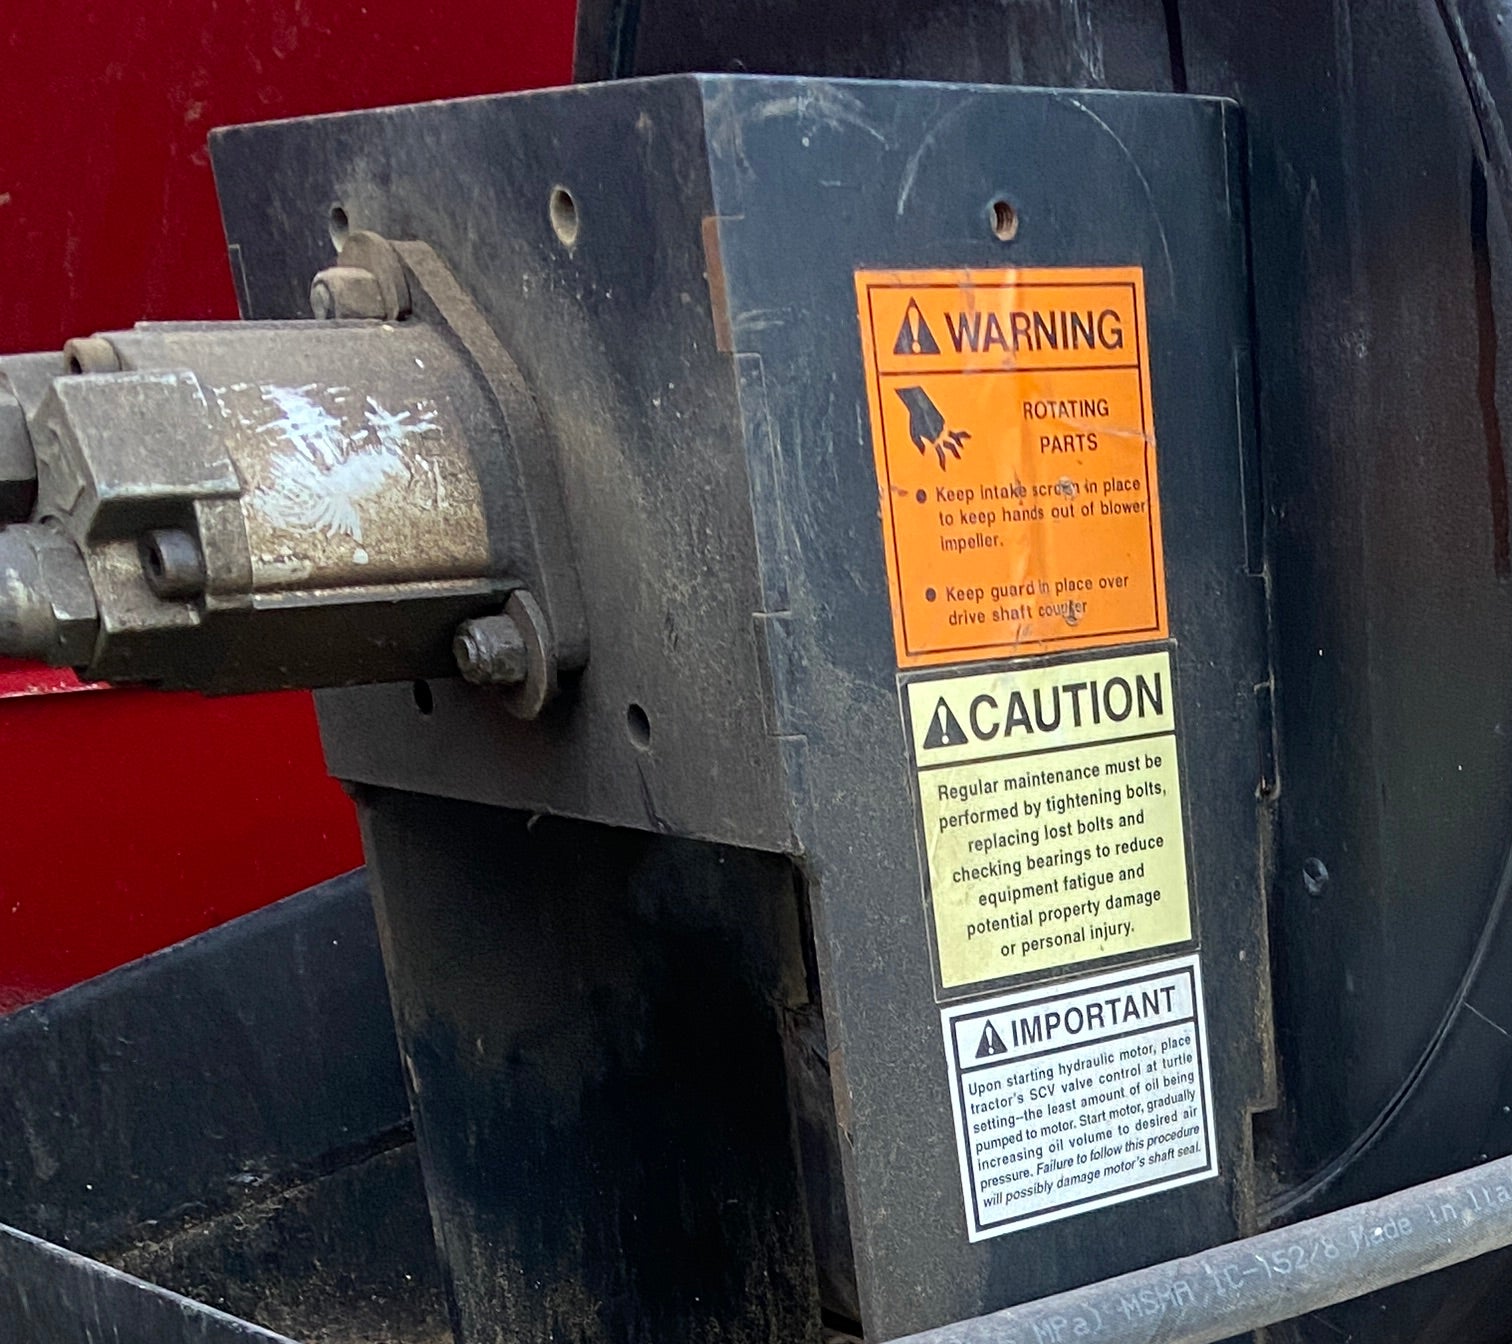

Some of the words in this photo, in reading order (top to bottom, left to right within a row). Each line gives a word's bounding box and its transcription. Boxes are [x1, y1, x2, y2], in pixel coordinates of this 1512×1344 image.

[944, 309, 1123, 353] WARNING
[1023, 399, 1109, 420] ROTATING
[1040, 433, 1098, 453] PARTS
[936, 486, 974, 507] Keep
[980, 482, 1027, 500] intake
[1032, 482, 1080, 496] scren
[1084, 478, 1098, 494] in
[1103, 477, 1140, 496] place
[939, 510, 953, 526] to
[960, 507, 996, 527] keep
[1002, 502, 1044, 521] hands
[1051, 504, 1075, 518] out
[1081, 502, 1094, 517] of
[1101, 501, 1146, 515] blower
[941, 533, 1004, 553] impeller.
[945, 583, 985, 604] Keep
[990, 580, 1035, 601] guard
[1039, 580, 1050, 594] in
[1055, 578, 1092, 596] place
[1099, 576, 1129, 589] over
[949, 607, 985, 626] drive
[992, 601, 1032, 619] shaft
[969, 672, 1164, 740] CAUTION
[938, 780, 998, 802] Regular
[1004, 765, 1099, 790] maintenance
[1105, 758, 1141, 776] must
[1145, 754, 1162, 768] be
[939, 803, 1018, 833] performed
[1024, 800, 1041, 818] by
[1046, 788, 1121, 812] tightening
[1126, 781, 1166, 800] bolts,
[968, 828, 1040, 852] replacing
[1044, 824, 1073, 840] lost
[1077, 817, 1113, 834] bolts
[1118, 810, 1145, 827] and
[952, 860, 1022, 884] checking
[1026, 849, 1091, 870] bearings
[1095, 844, 1110, 858] to
[1115, 836, 1164, 855] reduce
[978, 881, 1059, 907] equipment
[1063, 871, 1114, 893] fatigue
[1118, 863, 1145, 880] and
[967, 913, 1033, 939] potential
[1038, 900, 1100, 923] property
[1105, 889, 1161, 911] damage
[1001, 941, 1016, 956] or
[1021, 931, 1085, 954] personal
[1090, 920, 1135, 943] injury.
[1011, 985, 1176, 1047] IMPORTANT
[968, 1081, 1001, 1097] Upon
[1007, 1067, 1054, 1087] starting
[1058, 1052, 1115, 1075] hydraulic
[1119, 1043, 1157, 1061] motor,
[1161, 1035, 1191, 1053] place
[971, 1093, 1024, 1114] tractor's
[1030, 1084, 1055, 1101] SCV
[1061, 1077, 1093, 1093] valve
[1099, 1063, 1141, 1085] control
[1146, 1062, 1158, 1073] at
[1162, 1052, 1193, 1069] turtle
[1047, 1099, 1076, 1115] least
[1080, 1088, 1125, 1108] amount
[1129, 1085, 1142, 1096] of
[1145, 1079, 1160, 1091] oil
[1163, 1071, 1194, 1087] being
[975, 1131, 1023, 1156] pumped
[1026, 1129, 1038, 1140] to
[1040, 1120, 1077, 1136] motor.
[1079, 1111, 1107, 1127] Start
[1109, 1101, 1144, 1119] motor,
[1146, 1089, 1196, 1111] gradually
[978, 1147, 1043, 1171] increasing
[1049, 1141, 1064, 1154] oil
[1068, 1129, 1113, 1148] volume
[1117, 1124, 1130, 1135] to
[1135, 1111, 1178, 1131] desired
[1183, 1106, 1198, 1119] air
[980, 1169, 1034, 1192] pressure.
[1036, 1157, 1074, 1175] Failure
[1076, 1152, 1088, 1164] to
[1089, 1145, 1123, 1161] follow
[1125, 1139, 1144, 1153] this
[1146, 1124, 1200, 1147] procedure
[983, 1191, 1003, 1208] will
[1005, 1179, 1053, 1205] possibly
[1056, 1167, 1101, 1189] damage
[1103, 1154, 1146, 1177] motor's
[1148, 1148, 1175, 1166] shaft
[1350, 1217, 1414, 1258] Made
